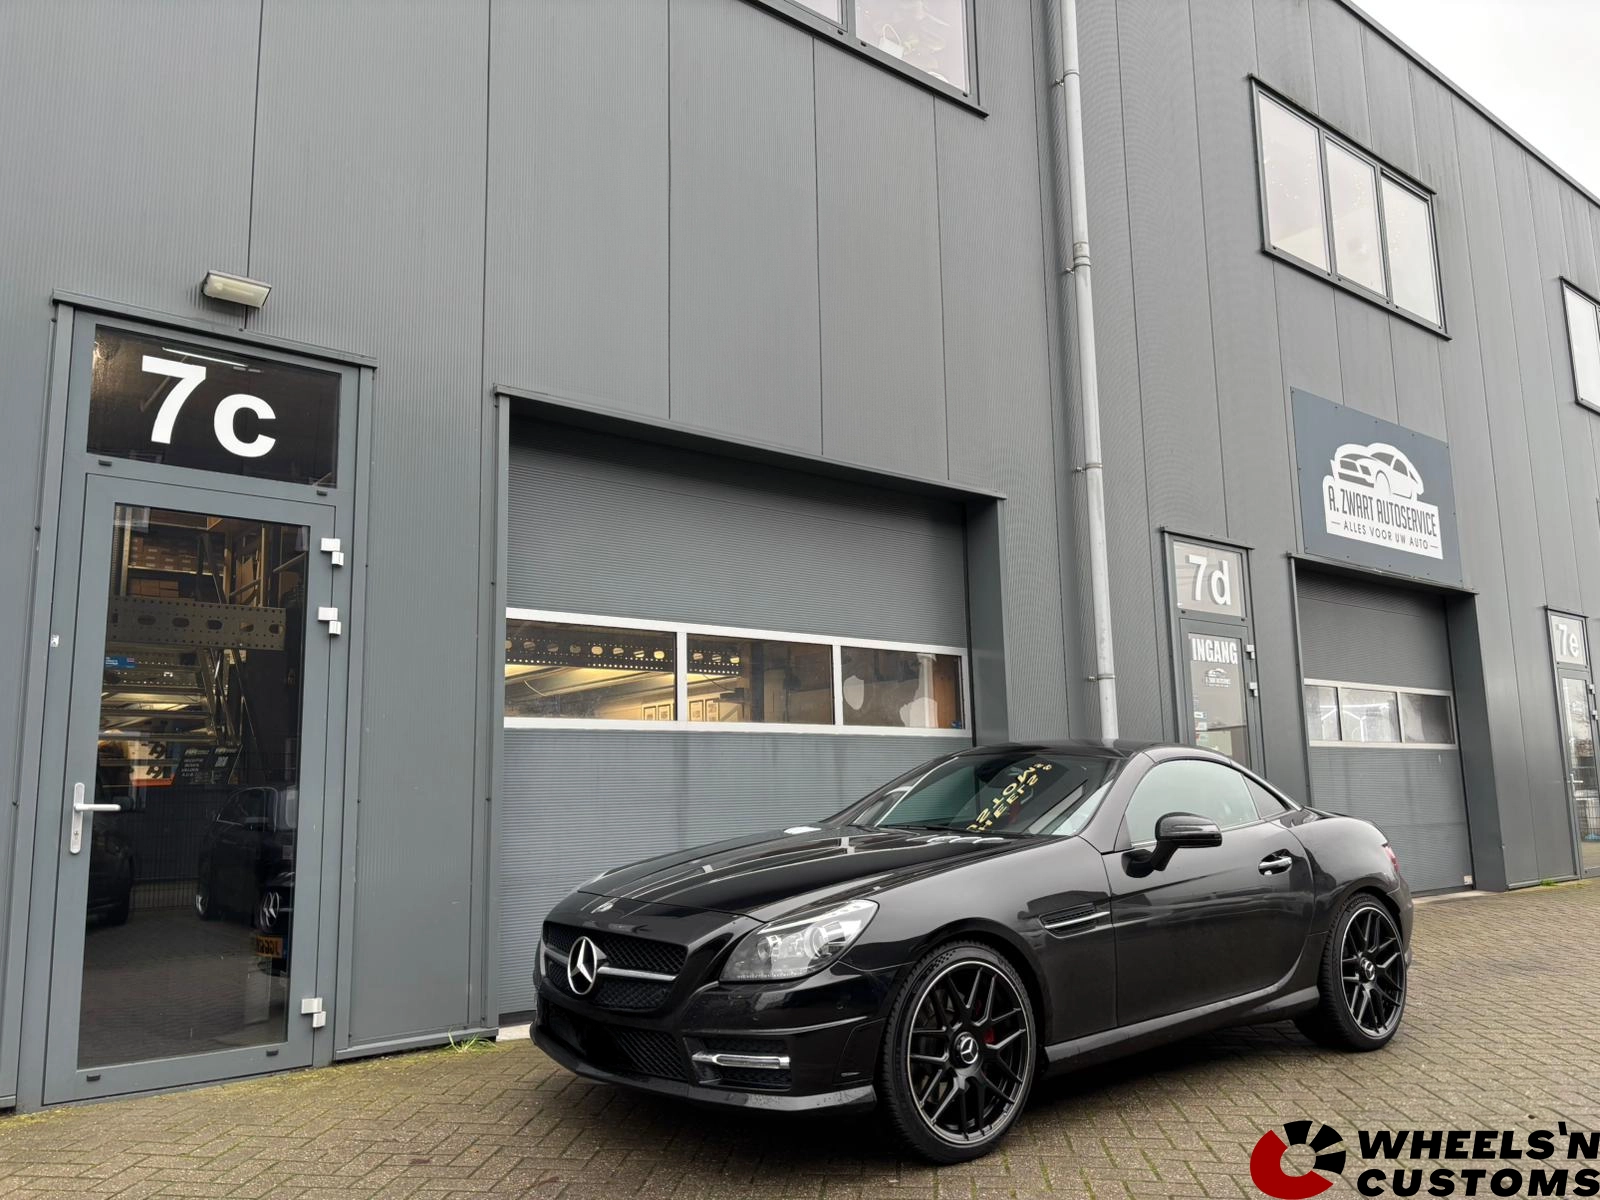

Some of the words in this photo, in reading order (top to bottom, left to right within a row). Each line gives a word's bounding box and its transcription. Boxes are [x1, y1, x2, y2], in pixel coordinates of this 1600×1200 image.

[141, 354, 277, 458] 7c
[1328, 485, 1340, 513] A.
[1340, 488, 1375, 521] ZWART
[1376, 498, 1438, 537] AUTOSERVICE
[1343, 520, 1367, 536] ALLES
[1369, 526, 1393, 541] VOOR
[1395, 533, 1406, 545] UW
[1409, 536, 1429, 550] AUTO
[1187, 553, 1232, 606] 7d
[1191, 638, 1238, 665] INGANG
[1558, 623, 1579, 657] 7e
